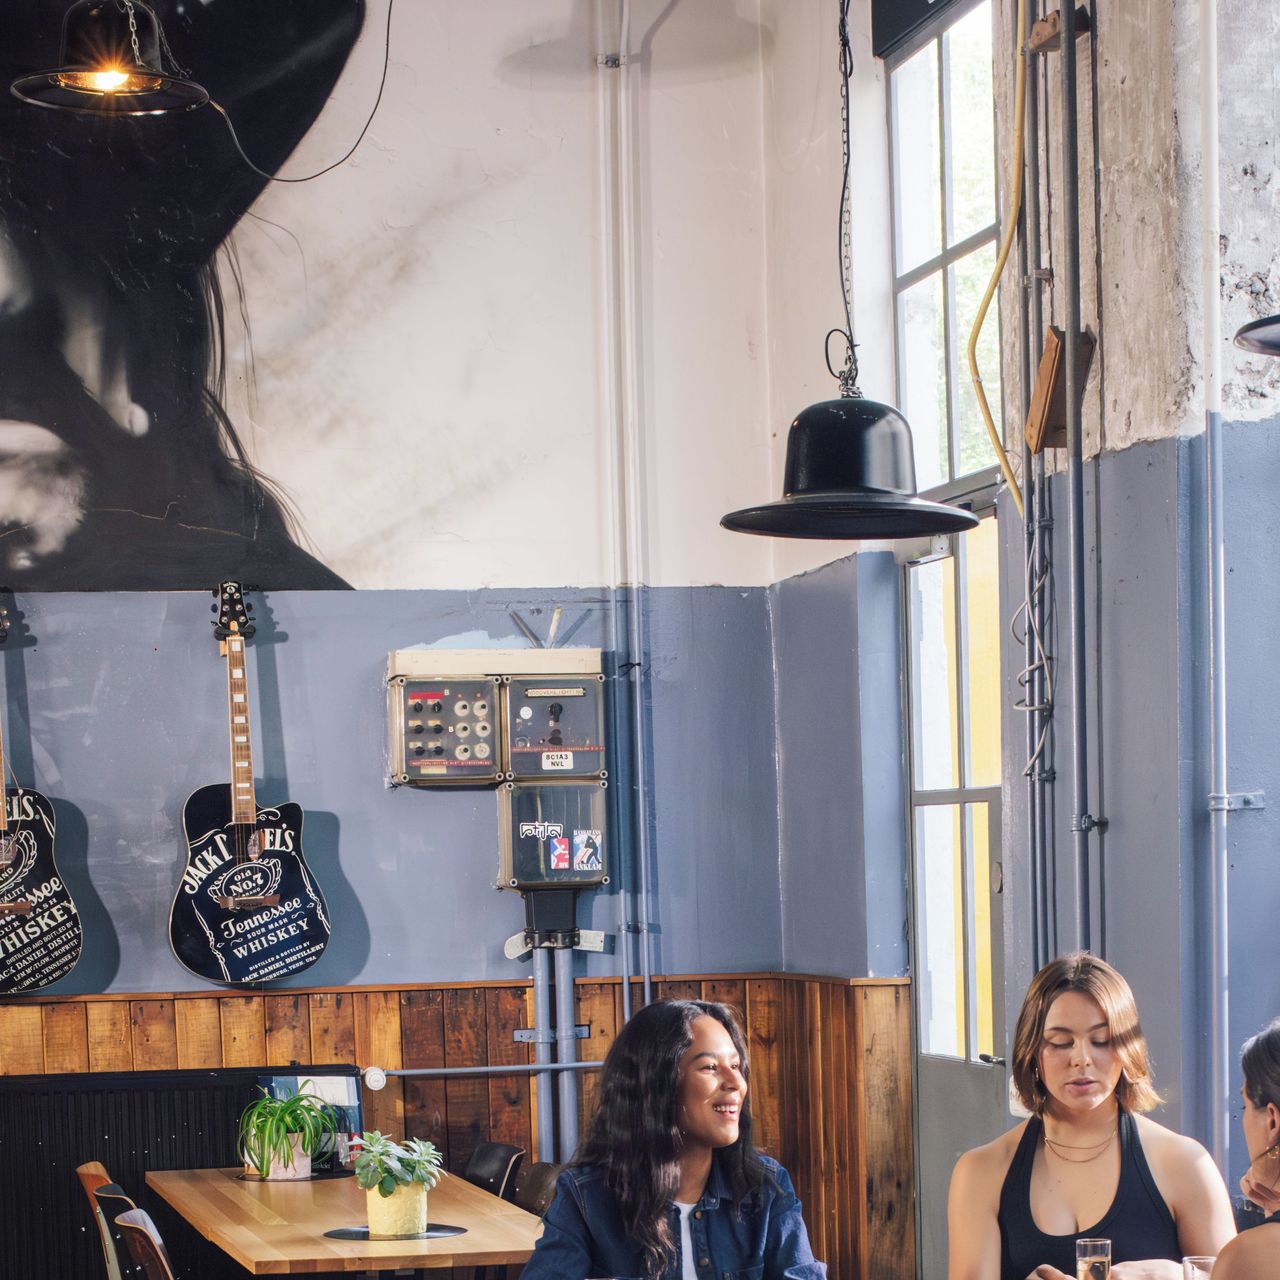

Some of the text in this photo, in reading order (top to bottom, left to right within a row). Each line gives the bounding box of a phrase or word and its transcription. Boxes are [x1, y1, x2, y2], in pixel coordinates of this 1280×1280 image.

[545, 753, 569, 761] 8C1A3
[184, 846, 222, 895] JACK
[234, 869, 253, 881] Old
[575, 863, 602, 871] ANKLAM
[220, 897, 303, 939] Tennessee
[246, 917, 289, 940] SOUR MASH
[232, 917, 310, 959] WHISKEY
[6, 946, 33, 966] DISTILLED
[32, 940, 44, 951] AND
[16, 947, 48, 971] DANIEL
[259, 961, 286, 977] DANIEL
[284, 942, 326, 965] DISTILLERY
[280, 944, 304, 958] BOTTLED
